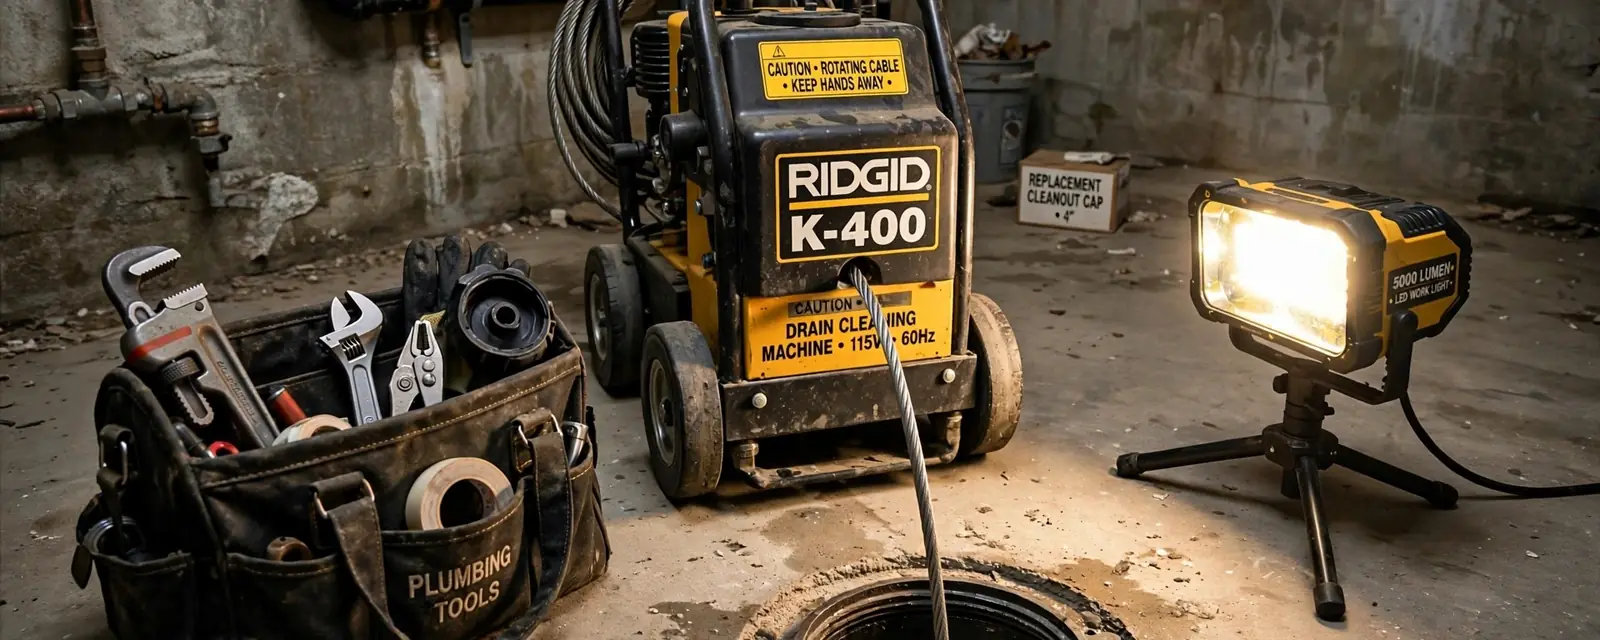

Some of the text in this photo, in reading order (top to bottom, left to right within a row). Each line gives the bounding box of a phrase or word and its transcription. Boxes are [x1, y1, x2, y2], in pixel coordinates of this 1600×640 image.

[768, 59, 900, 76] CAUTION ROTATING CABLE
[792, 76, 884, 92] KEEP HANDS AWAY
[788, 156, 930, 198] RIDGID
[1029, 173, 1102, 192] REPLACEMENT
[1027, 190, 1104, 210] CLEANOUT CAP
[792, 206, 926, 252] K-400
[1392, 261, 1451, 290] 5000 LUMEN
[1395, 280, 1450, 304] LED WORK LIGHT
[796, 298, 852, 314] CAUTION
[786, 319, 834, 339] DRAIN
[762, 339, 832, 362] MACHINE
[902, 328, 936, 346] 60Hz
[408, 545, 511, 598] PLUMBING
[434, 580, 500, 623] TOOLS
